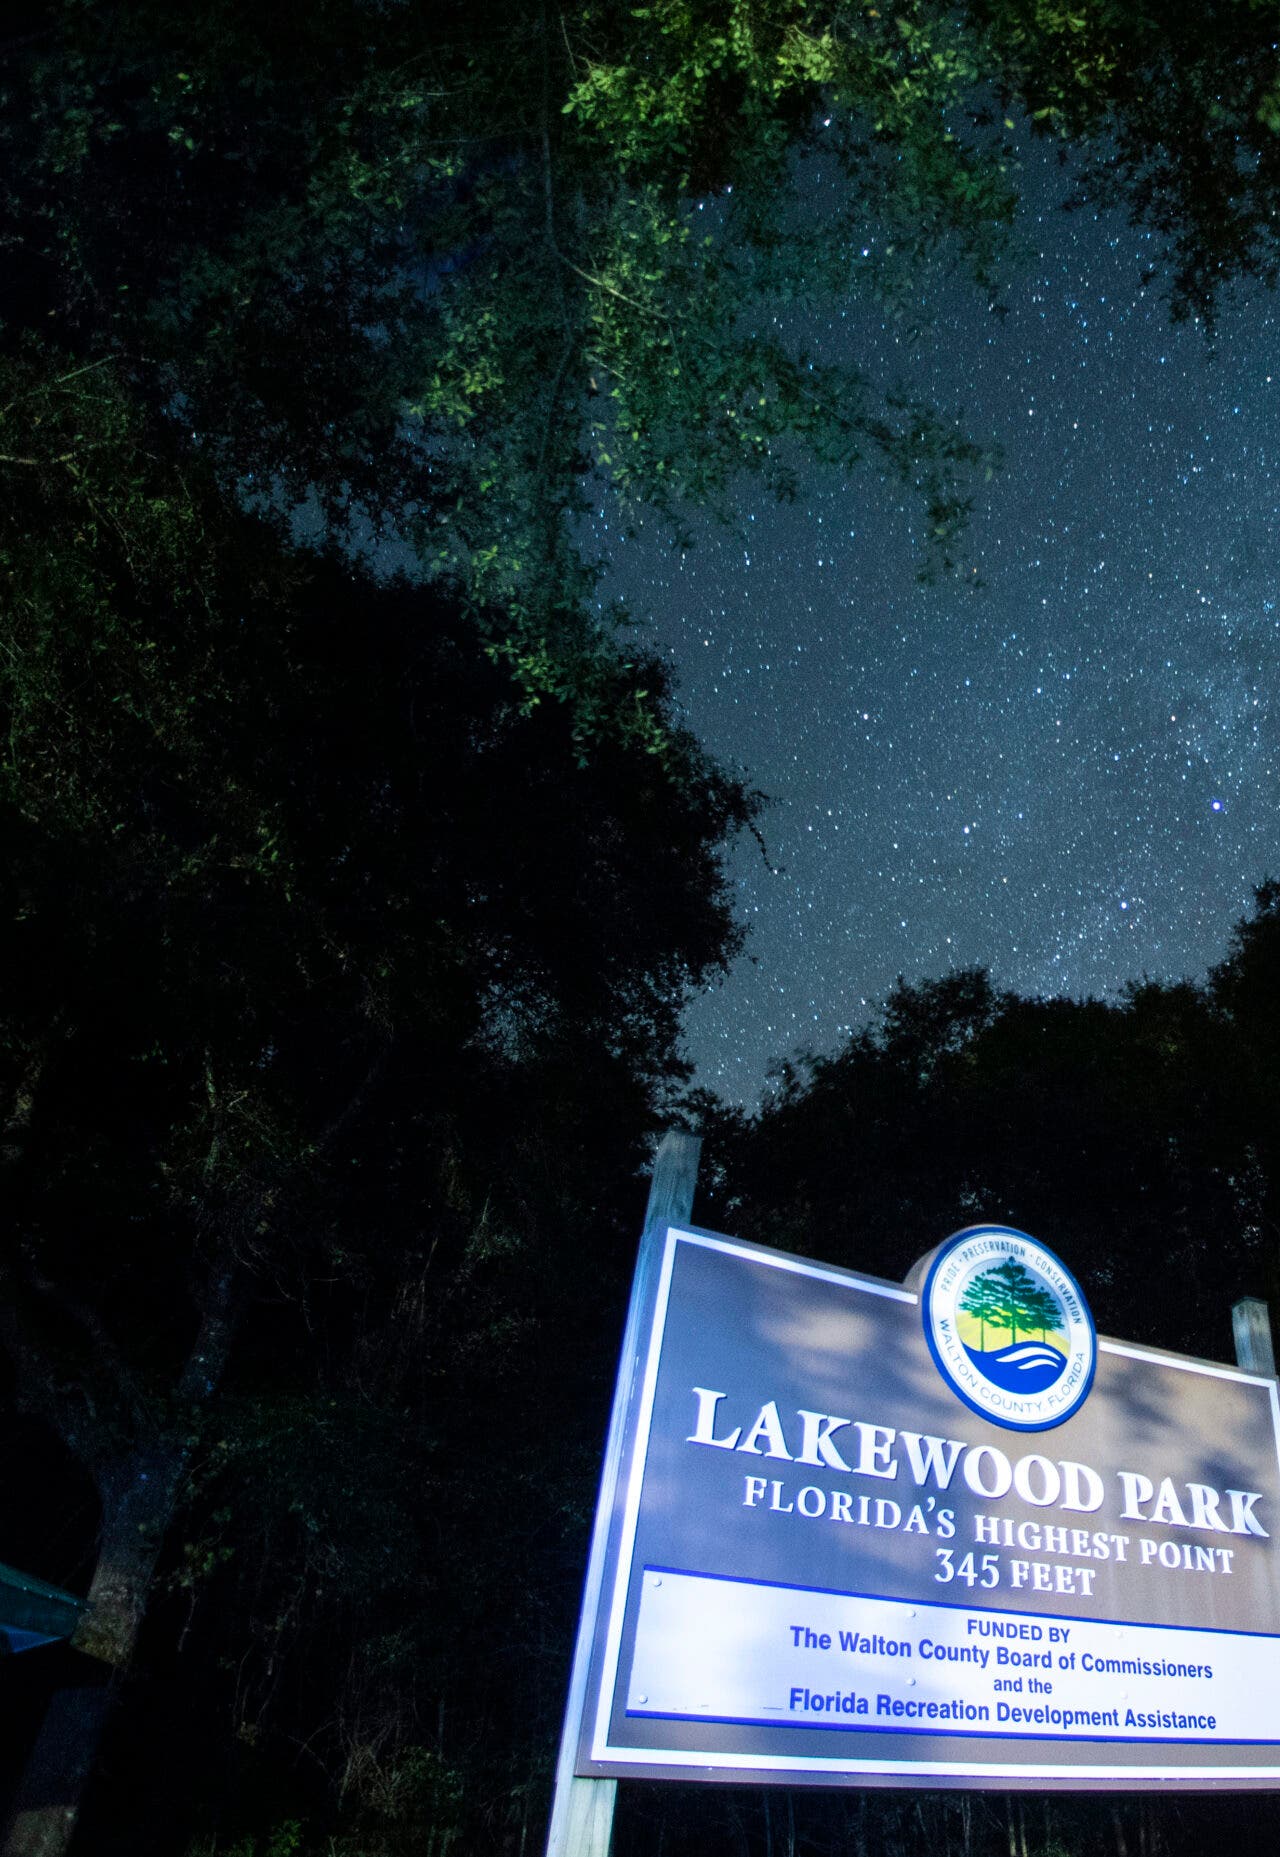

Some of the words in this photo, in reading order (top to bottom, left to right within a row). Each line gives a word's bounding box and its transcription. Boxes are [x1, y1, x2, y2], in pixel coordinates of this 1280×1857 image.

[941, 1263, 961, 1292] PRIDE
[962, 1240, 1026, 1262] PRESERVATION
[1035, 1255, 1083, 1325] CONSERVATION
[940, 1318, 978, 1388] WALTON
[1047, 1352, 1085, 1408] FLORIDA
[686, 1386, 1105, 1512] LAKEWOOD
[1116, 1471, 1270, 1538] PARK
[743, 1475, 956, 1539] FLORIDA'S
[974, 1514, 1129, 1562] HIGHEST
[1140, 1538, 1234, 1574] POINT
[934, 1547, 1000, 1588] 345
[1010, 1559, 1096, 1596] FEET
[789, 1625, 832, 1650] The
[839, 1630, 912, 1658] Walton
[918, 1638, 990, 1669] County
[996, 1646, 1052, 1668] Board
[1058, 1652, 1076, 1671] of
[1081, 1653, 1213, 1679] Commissioners
[967, 1618, 1043, 1641] FUNDED
[1049, 1626, 1071, 1644] BY
[789, 1687, 869, 1715] Florida
[876, 1693, 990, 1721] Recreation
[996, 1701, 1119, 1729] Development
[1124, 1708, 1217, 1730] Assistance
[993, 1676, 1023, 1693] and
[1028, 1678, 1053, 1695] the
